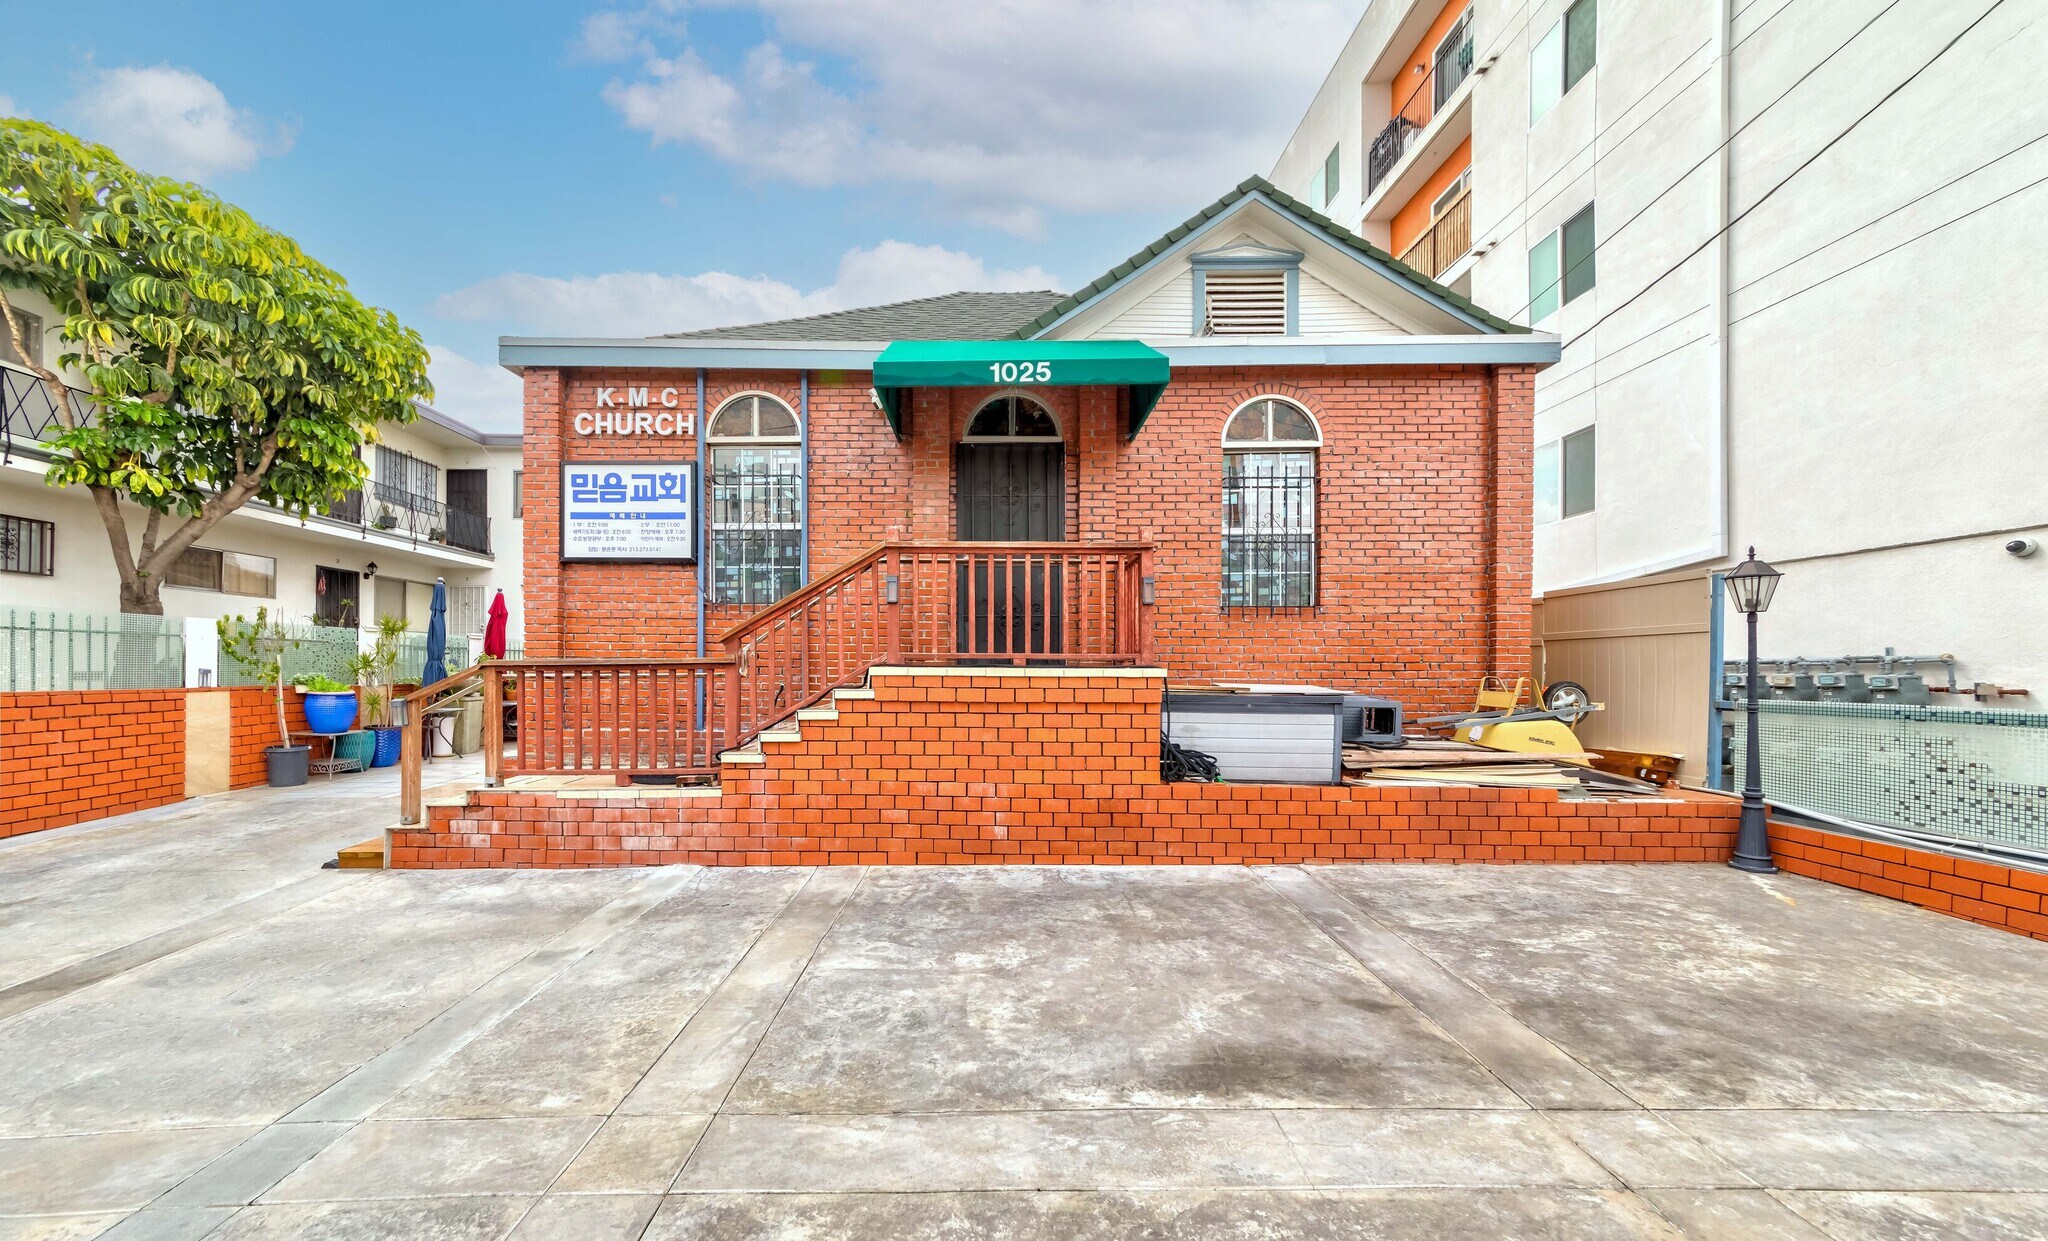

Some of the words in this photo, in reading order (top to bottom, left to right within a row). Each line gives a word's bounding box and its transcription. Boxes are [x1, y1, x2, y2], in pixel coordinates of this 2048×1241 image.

[989, 361, 1052, 382] 1025
[574, 412, 695, 436] CHURCH
[571, 472, 627, 503] 믿음
[630, 472, 686, 503] 교회
